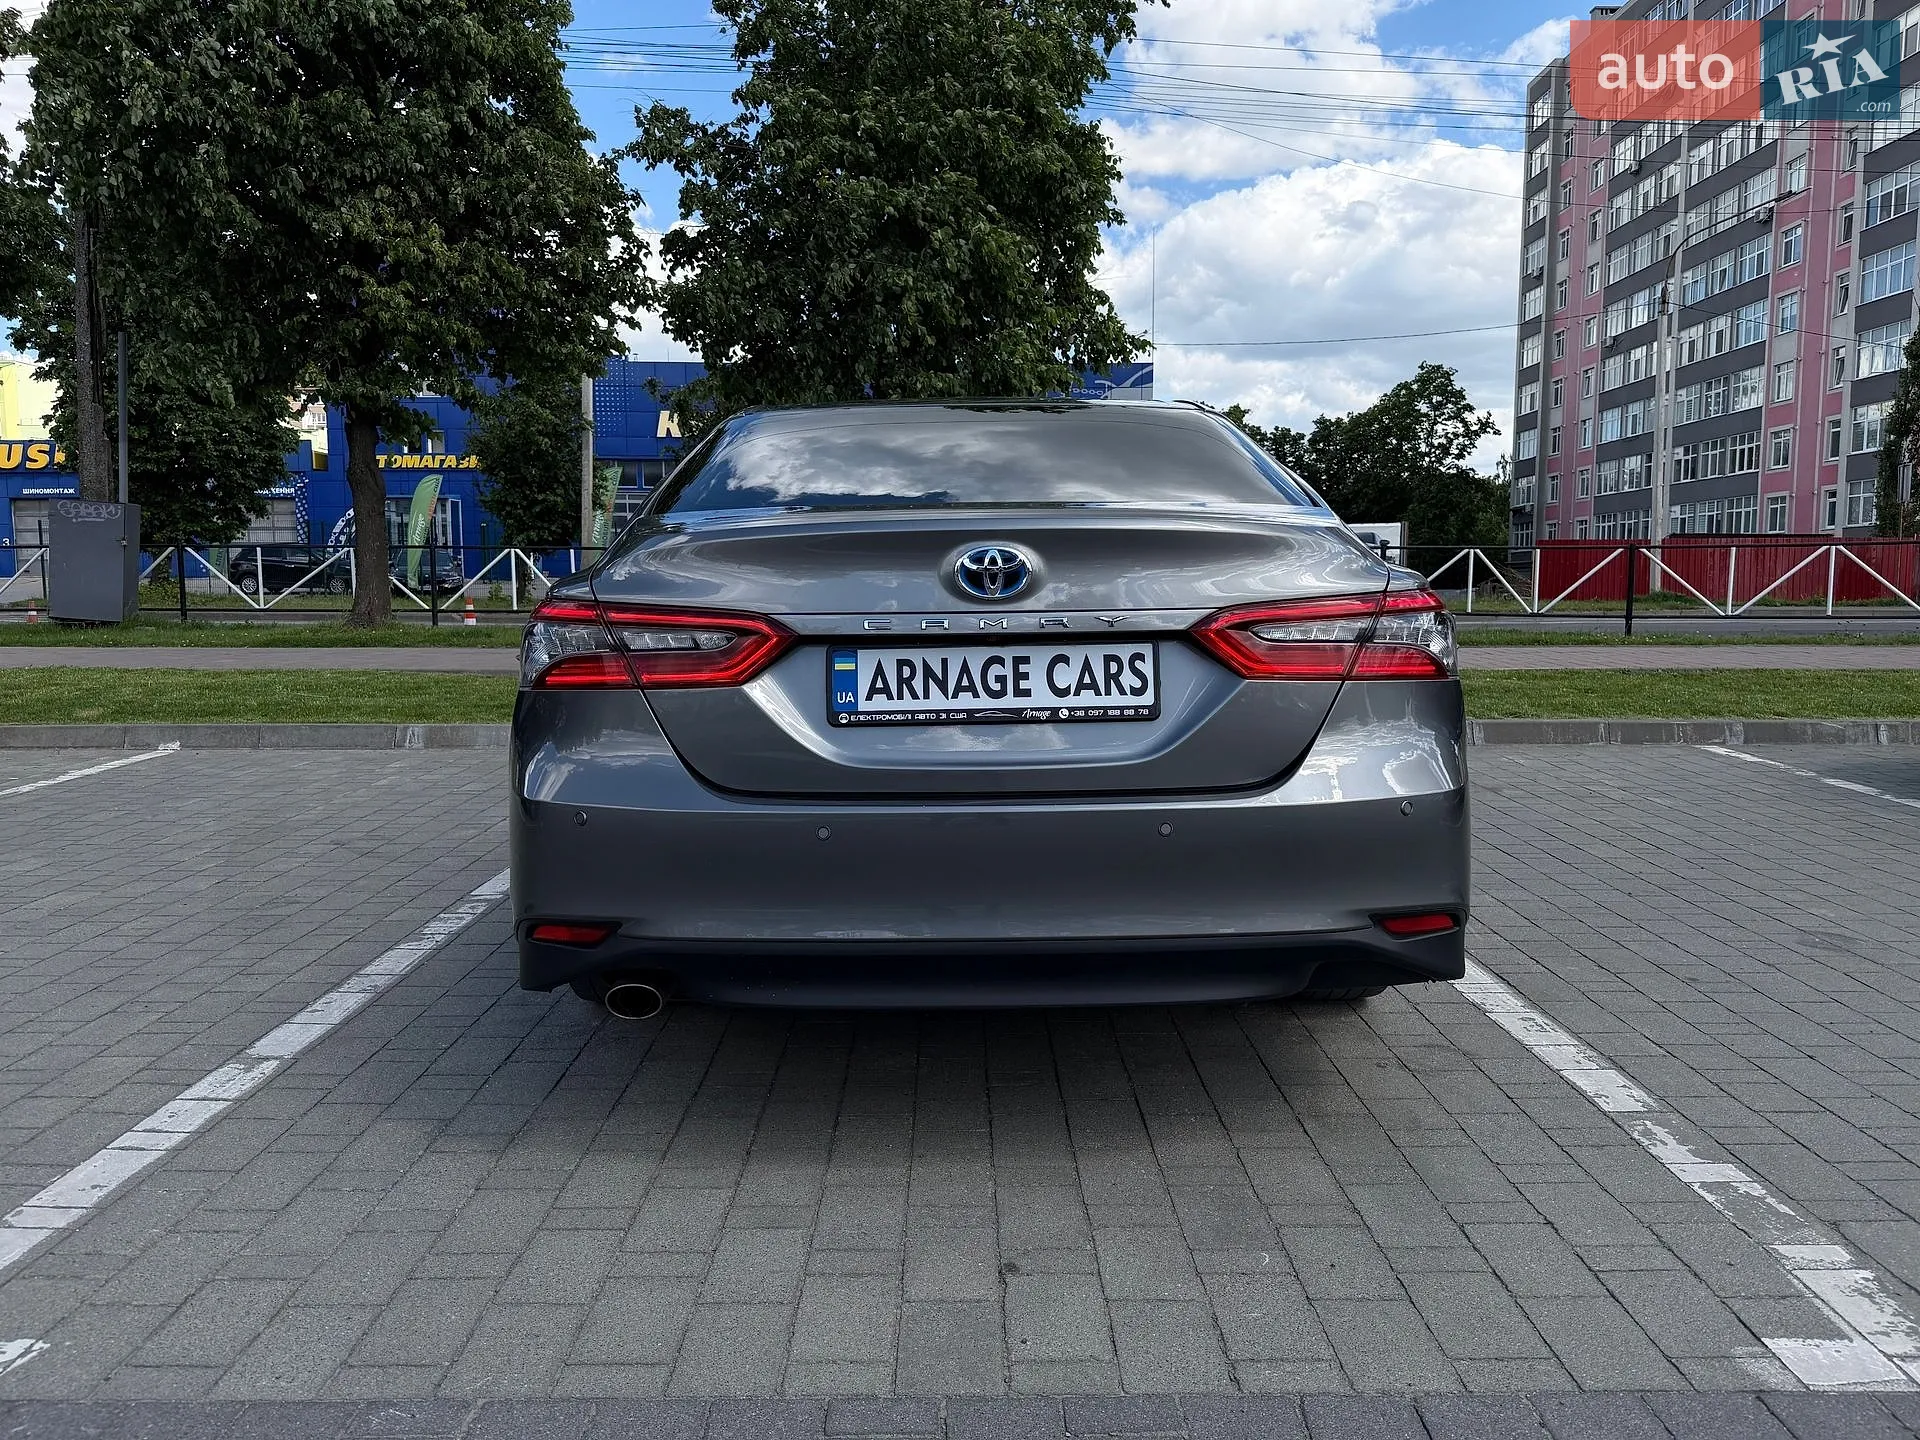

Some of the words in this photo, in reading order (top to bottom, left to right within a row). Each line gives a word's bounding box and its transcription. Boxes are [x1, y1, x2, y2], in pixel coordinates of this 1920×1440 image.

[22, 487, 76, 495] ШИНОМОНТАЖ
[863, 616, 1130, 630] CAMRY
[864, 654, 1032, 702] ARNAGE
[1046, 652, 1149, 698] CARS
[837, 691, 855, 704] UA
[1088, 709, 1103, 717] 097
